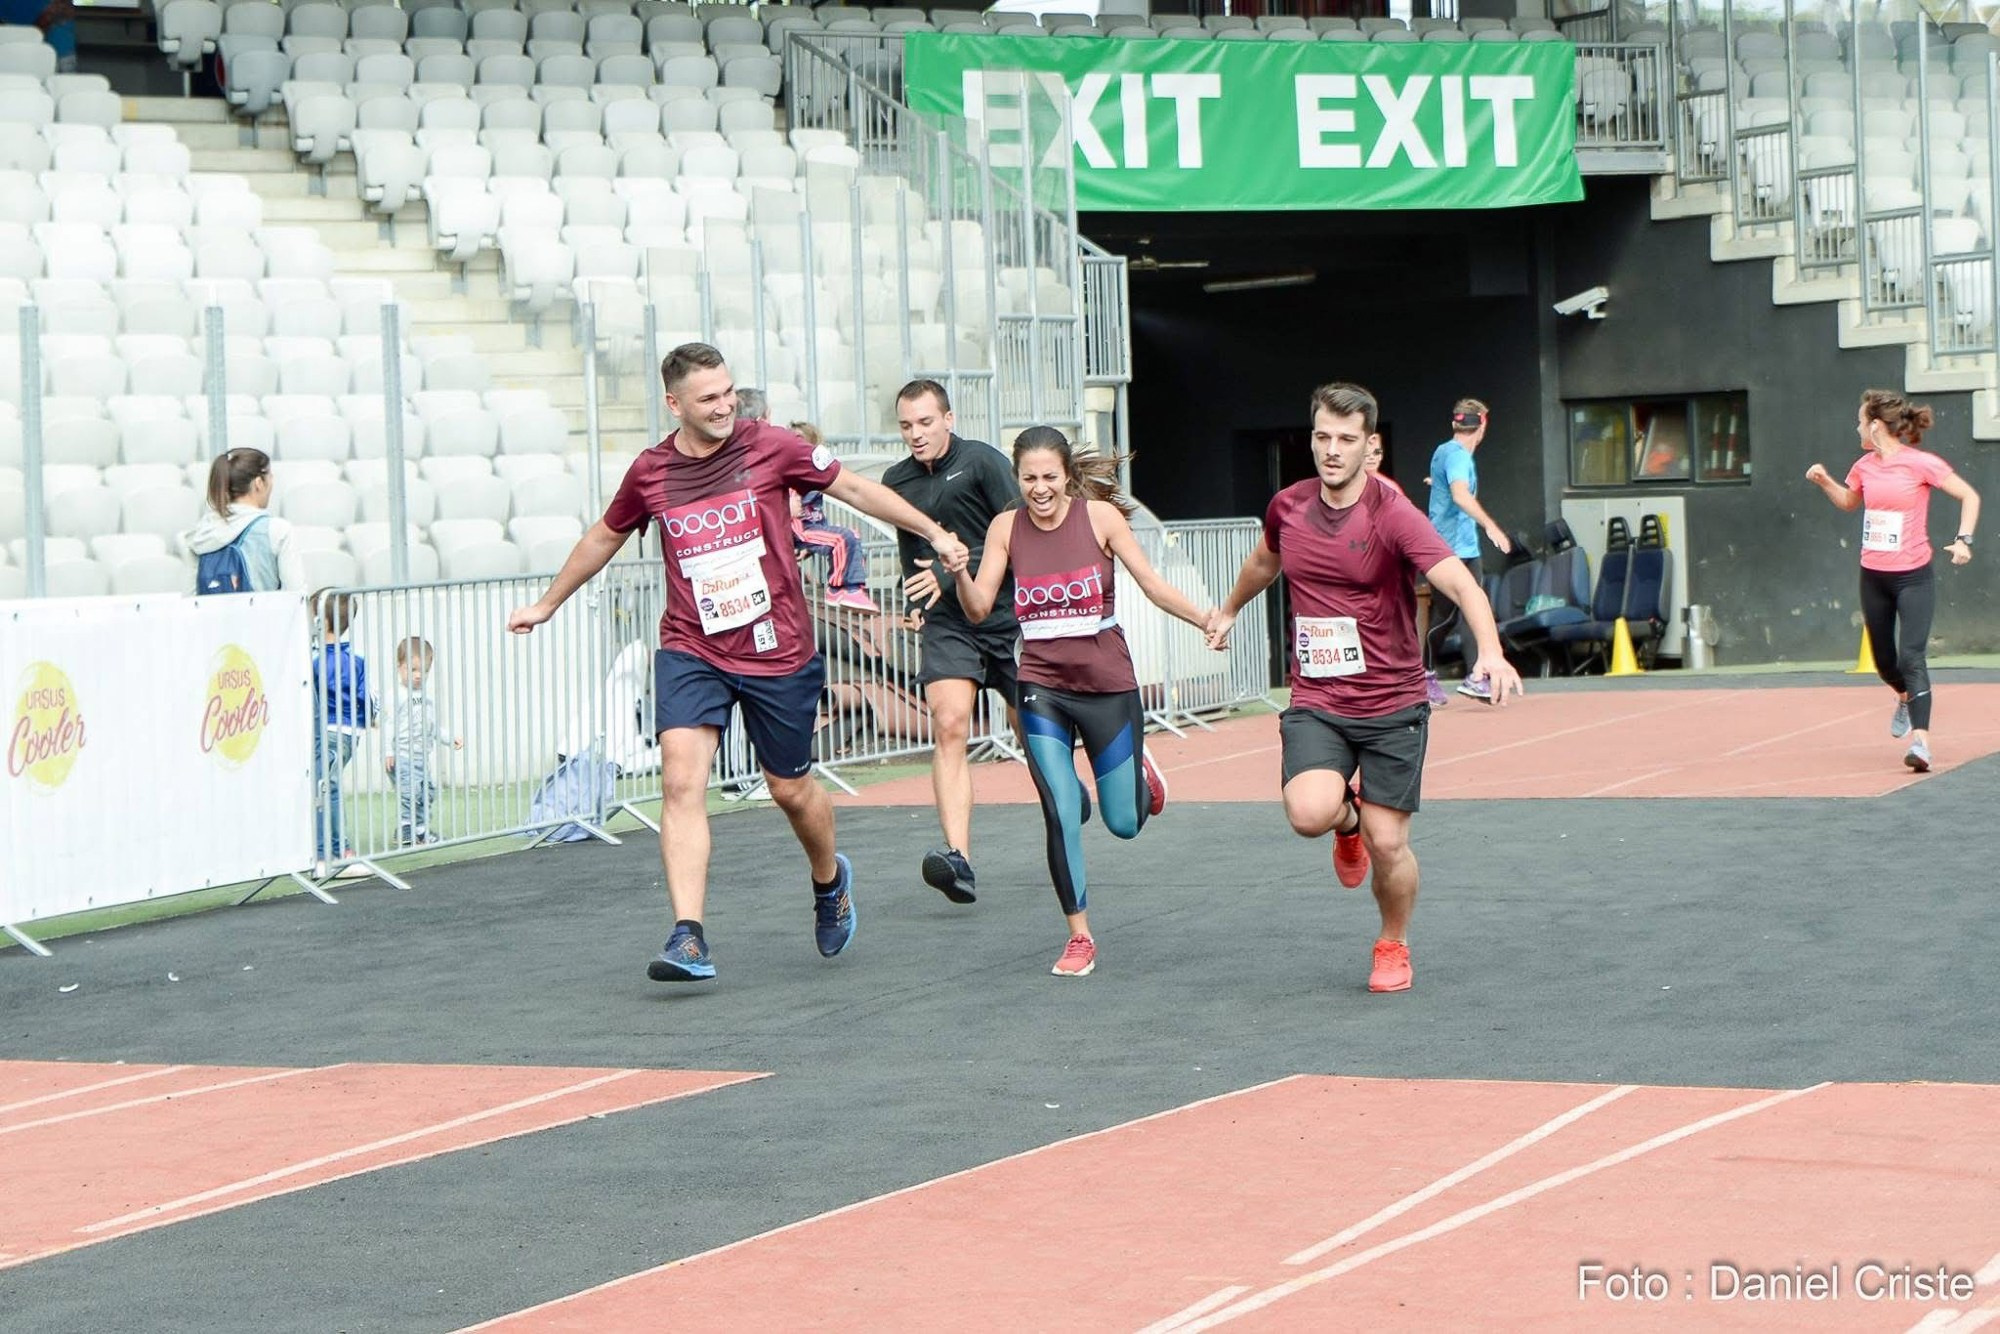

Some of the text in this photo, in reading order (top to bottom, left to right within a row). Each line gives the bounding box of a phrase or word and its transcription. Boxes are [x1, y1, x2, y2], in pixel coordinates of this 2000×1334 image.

[962, 69, 1536, 169] EXIT EXIT
[662, 489, 758, 539] bogart
[676, 528, 760, 558] CONSTRUCT
[1014, 566, 1103, 608] bogart
[719, 596, 751, 618] 8534
[1312, 648, 1341, 665] 8534
[217, 669, 252, 690] URSUS
[25, 687, 66, 710] URSUS
[200, 687, 270, 754] Cooler
[7, 707, 87, 778] Cooler
